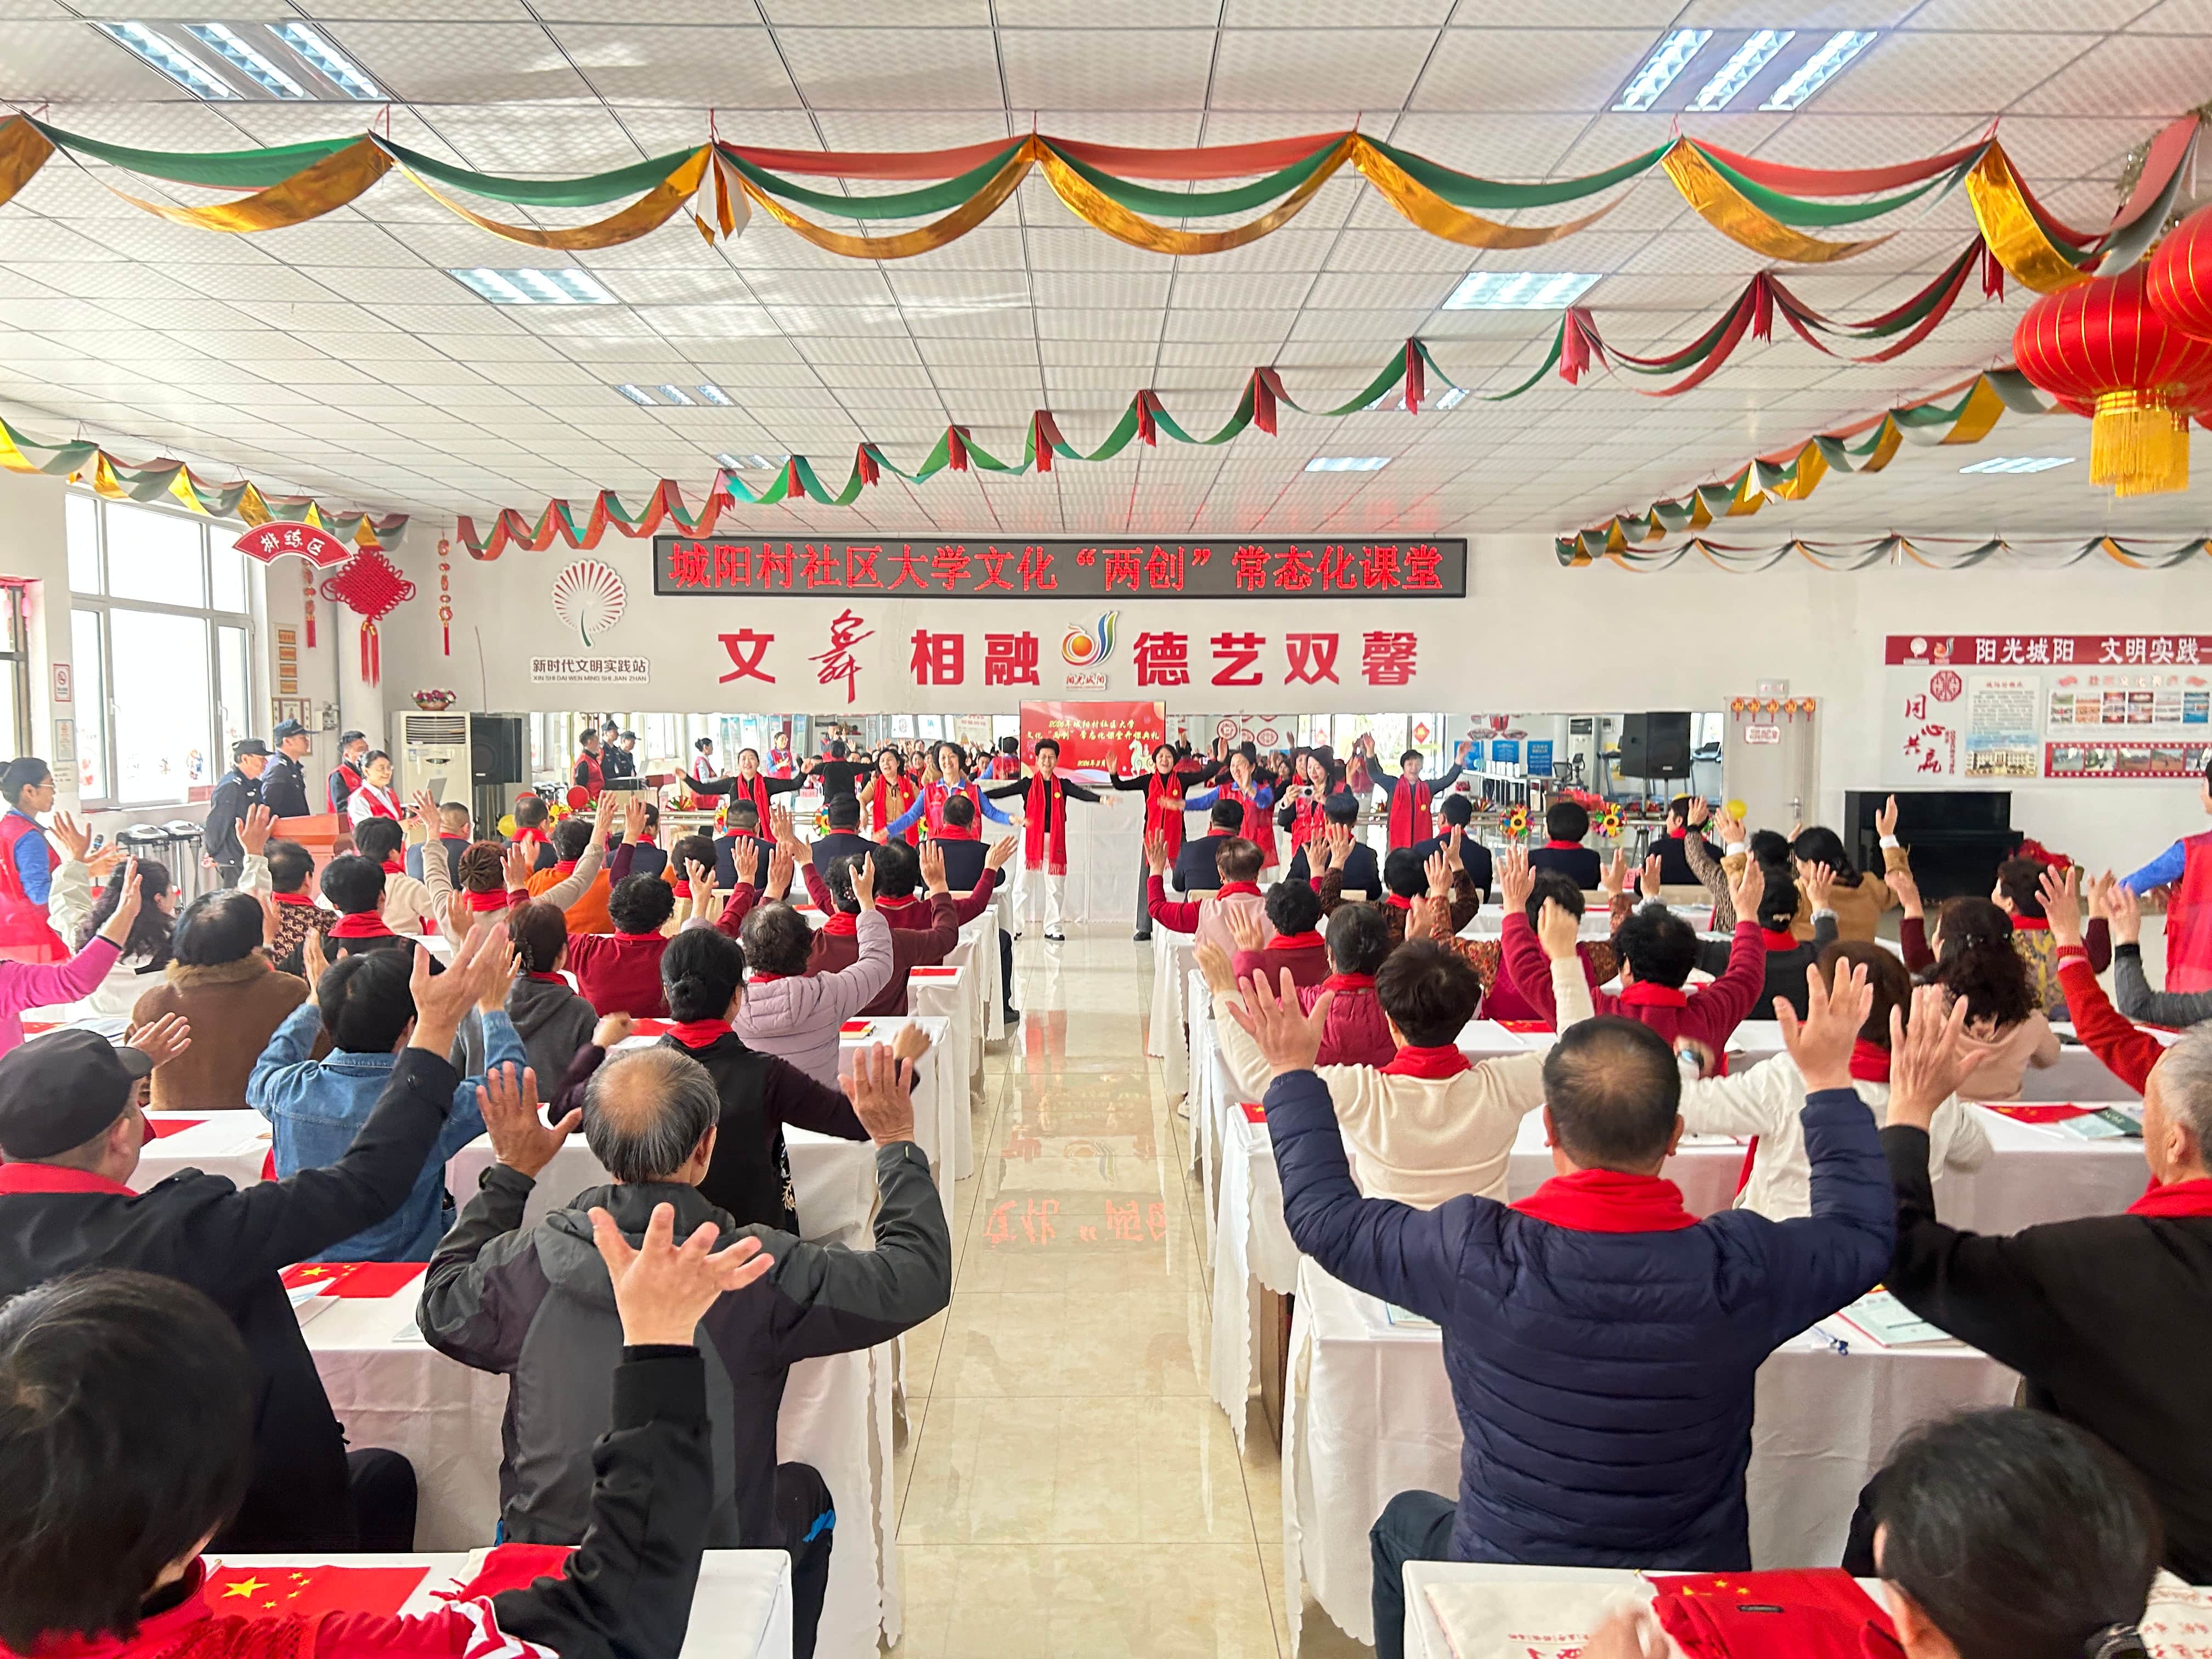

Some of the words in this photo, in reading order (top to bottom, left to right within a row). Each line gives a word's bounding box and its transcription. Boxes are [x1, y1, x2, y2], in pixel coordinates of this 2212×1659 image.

[260, 528, 325, 556] 排练区
[667, 543, 1443, 591] 城阳村社区大学文化“两创”常态化课堂
[1133, 630, 1418, 687] 德艺双馨
[1974, 637, 2074, 664] 阳光城阳
[533, 659, 646, 673] 新时代文明实践站
[1066, 674, 1105, 685] 阳光城阳
